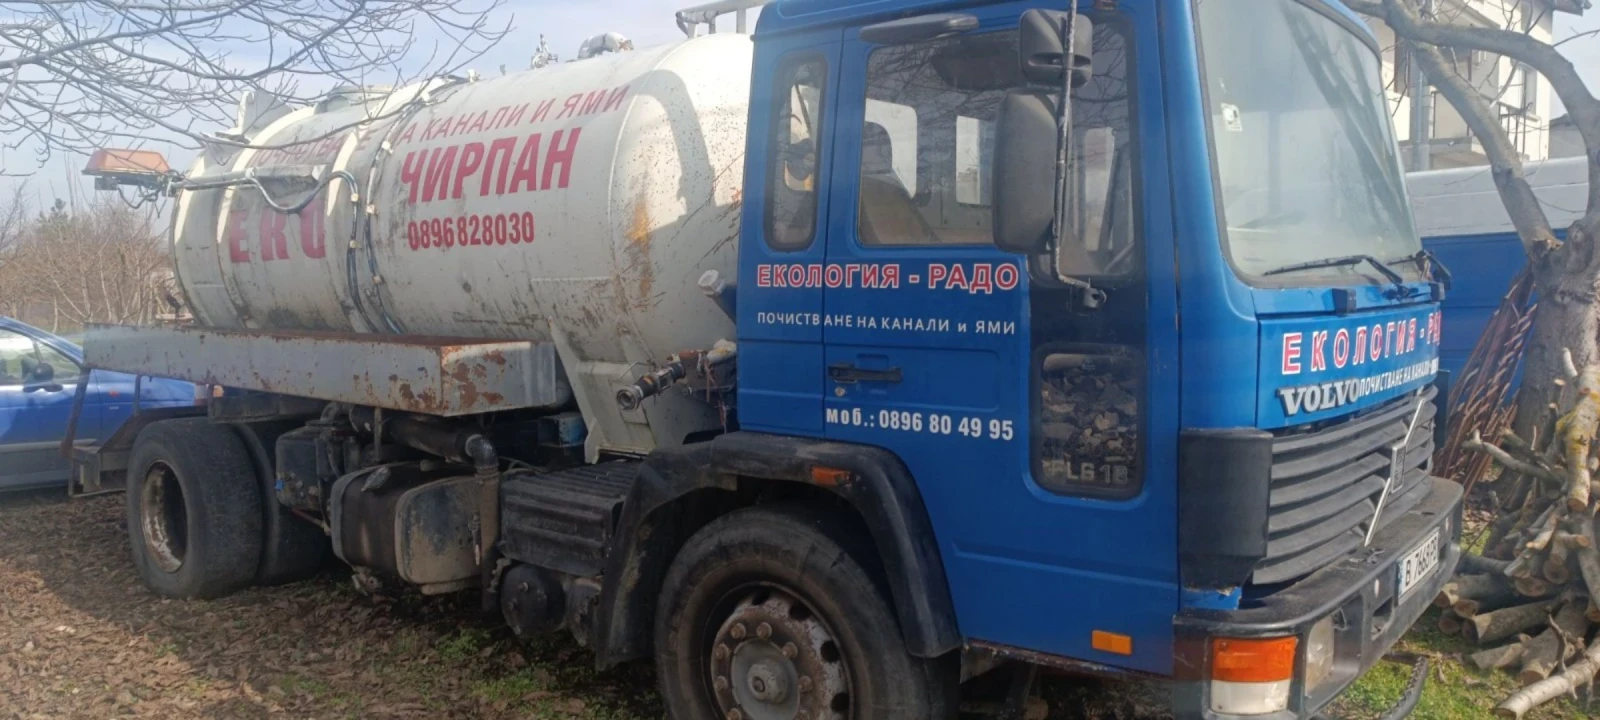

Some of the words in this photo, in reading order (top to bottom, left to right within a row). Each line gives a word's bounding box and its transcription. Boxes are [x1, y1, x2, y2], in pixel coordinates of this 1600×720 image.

[420, 102, 530, 142] КАНАЛИ
[529, 98, 556, 123] И
[555, 85, 631, 120] ЯМИ
[401, 127, 582, 206] ЧИРПАН
[757, 264, 900, 289] ЕКОЛОГИЯ
[928, 263, 1019, 294] РАДО
[857, 316, 877, 329] НА
[882, 317, 949, 332] КАНАЛИ
[975, 320, 1015, 335] ЯМИ
[1282, 318, 1417, 375] ЕКОЛОГИЯ
[1278, 378, 1360, 416] VOLVO
[879, 410, 923, 433] 0896
[929, 415, 951, 435] 80
[958, 417, 982, 438] 49
[989, 419, 1014, 441] 95
[1405, 560, 1411, 587] B
